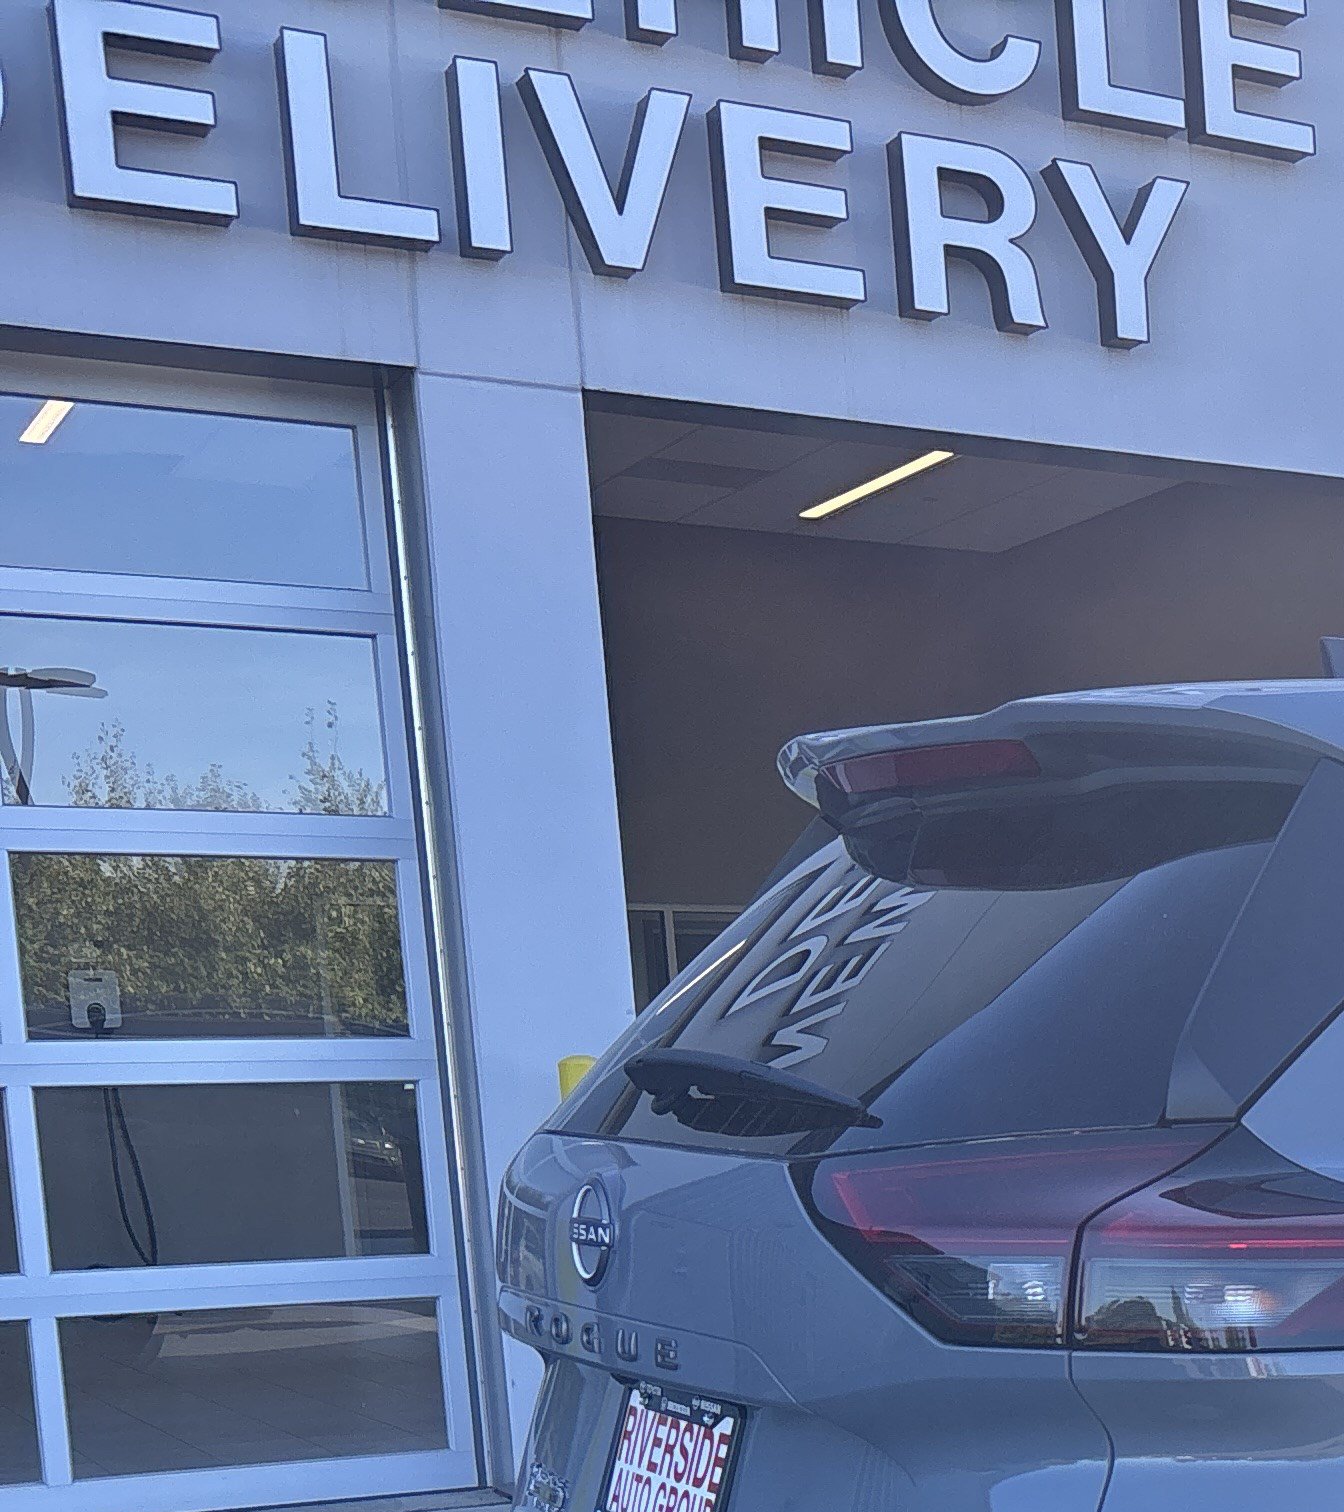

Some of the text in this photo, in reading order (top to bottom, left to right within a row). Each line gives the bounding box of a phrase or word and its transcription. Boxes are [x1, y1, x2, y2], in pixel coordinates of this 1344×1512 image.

[0, 0, 1190, 350] ELIVERY
[526, 1304, 680, 1371] ROGUE
[617, 1405, 733, 1494] RIVERSIDE
